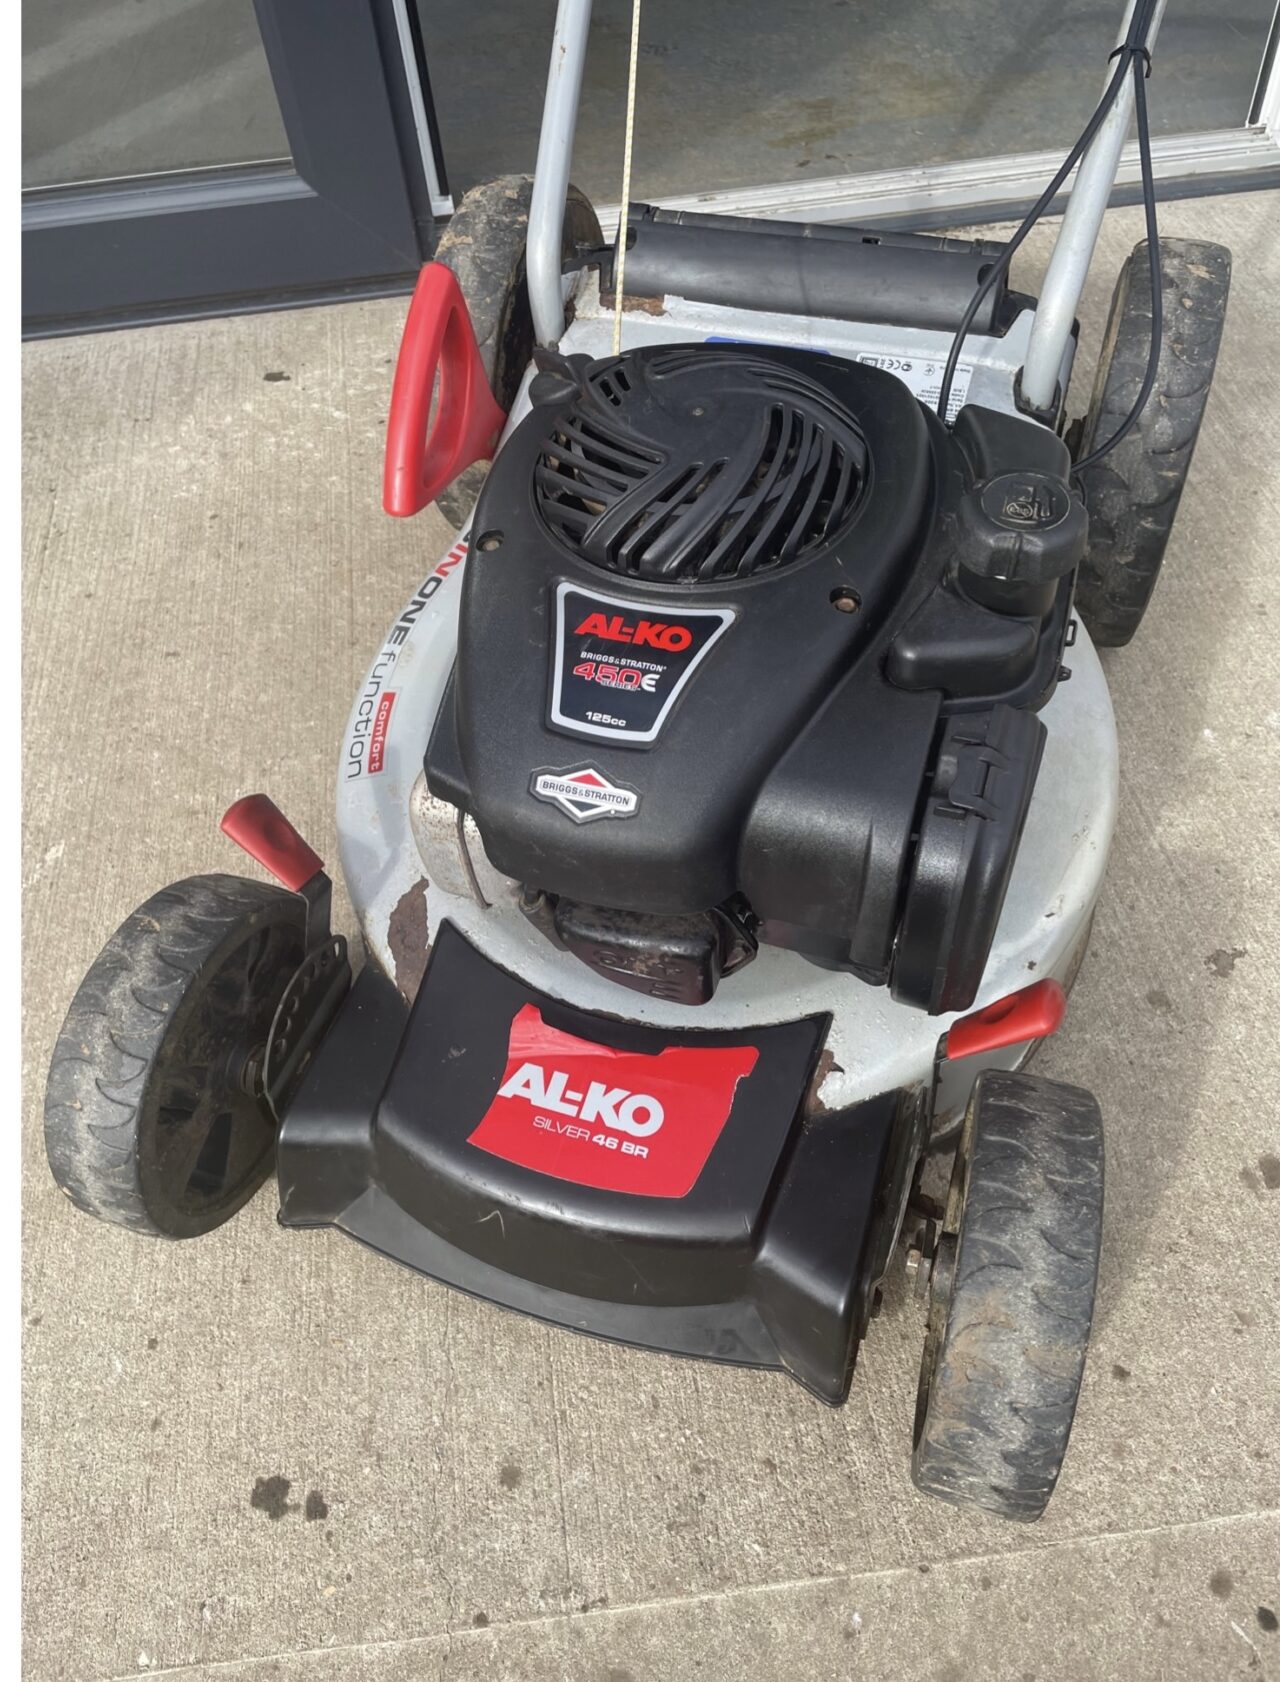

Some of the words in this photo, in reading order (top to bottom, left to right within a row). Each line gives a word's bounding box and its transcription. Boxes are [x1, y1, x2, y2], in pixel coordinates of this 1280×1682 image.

[387, 530, 471, 646] INONE
[574, 612, 693, 653] AL-KO
[347, 650, 396, 780] function
[370, 700, 390, 772] comfort
[585, 711, 626, 727] 125cc
[542, 780, 630, 806] BRIGGS&STRATTON
[497, 1062, 664, 1137] AL-KO
[532, 1115, 592, 1142] SILVER
[592, 1134, 619, 1150] 46
[620, 1141, 650, 1159] BR
